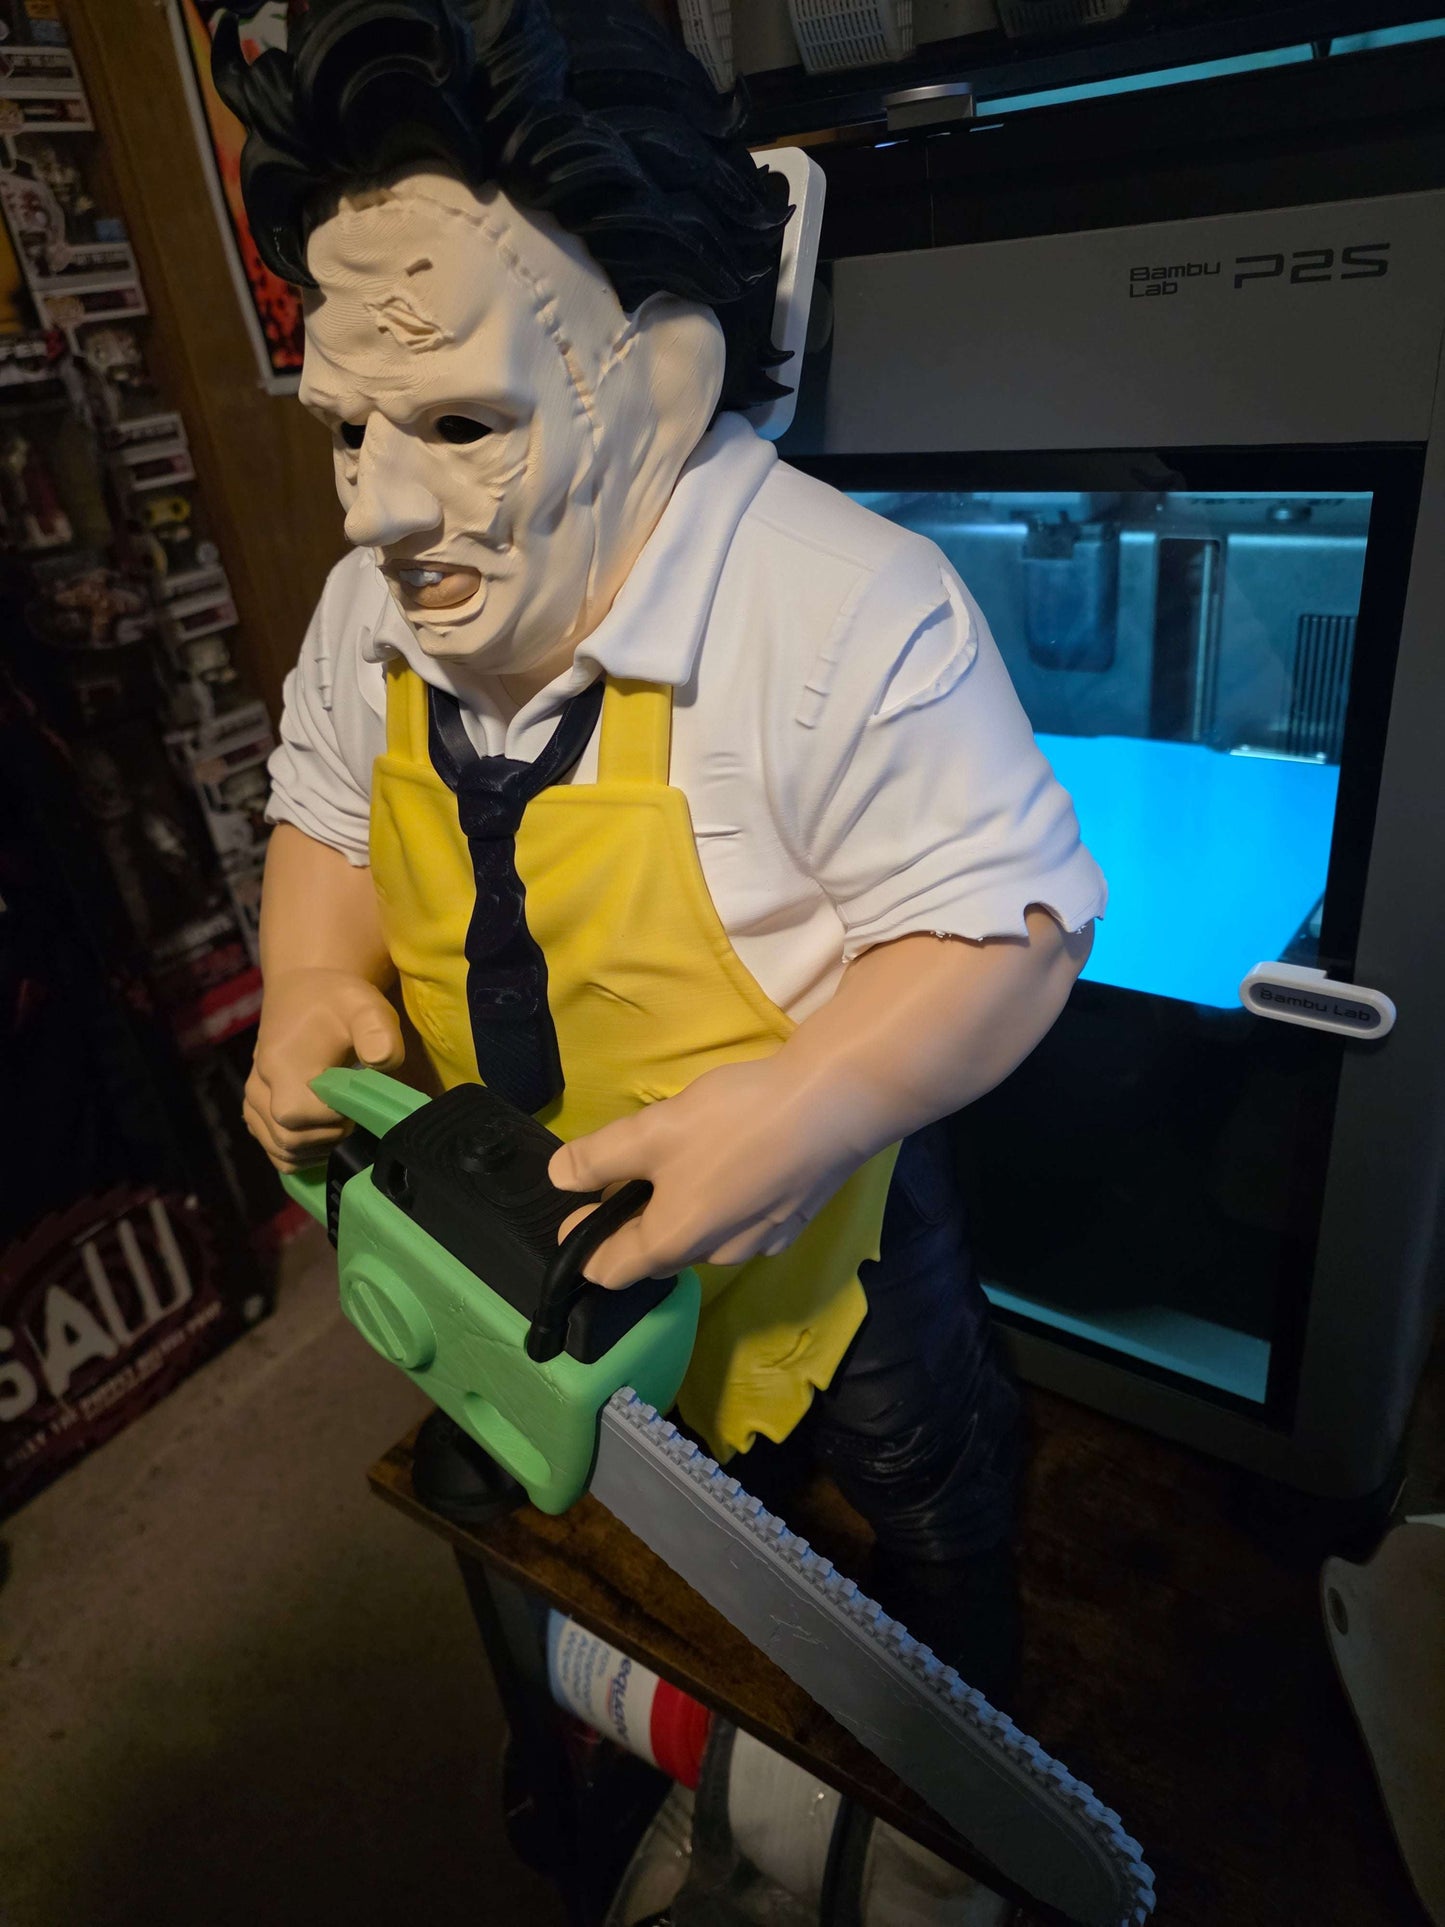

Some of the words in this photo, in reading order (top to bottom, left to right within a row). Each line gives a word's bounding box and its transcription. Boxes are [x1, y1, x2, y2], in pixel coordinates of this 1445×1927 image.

[1129, 261, 1221, 282] Bambu
[1234, 243, 1391, 289] P2S
[1129, 281, 1179, 298] Lab
[1259, 987, 1328, 1013] Bambu
[1333, 1004, 1371, 1022] Lab
